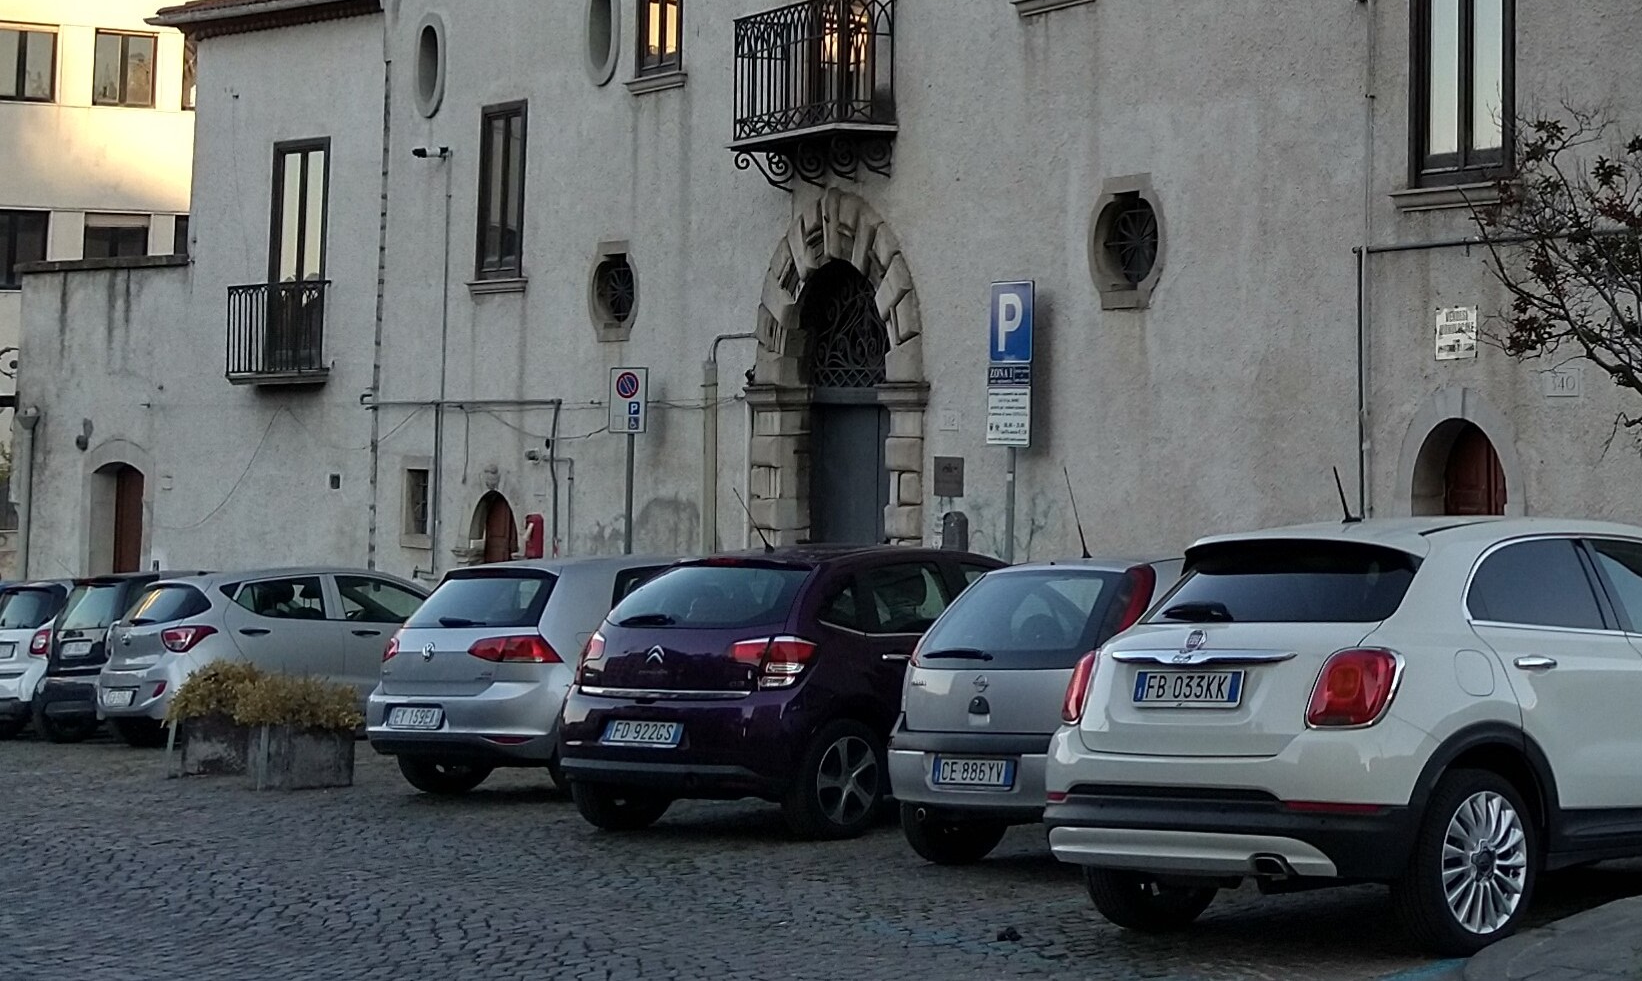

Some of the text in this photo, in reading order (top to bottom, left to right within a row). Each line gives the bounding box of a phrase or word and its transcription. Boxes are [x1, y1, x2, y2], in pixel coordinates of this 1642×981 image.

[997, 293, 1023, 352] P
[630, 403, 639, 414] P
[1145, 675, 1228, 699] FB 033KK
[612, 722, 674, 741] FD 922GS
[941, 761, 1004, 783] CE 886YV
